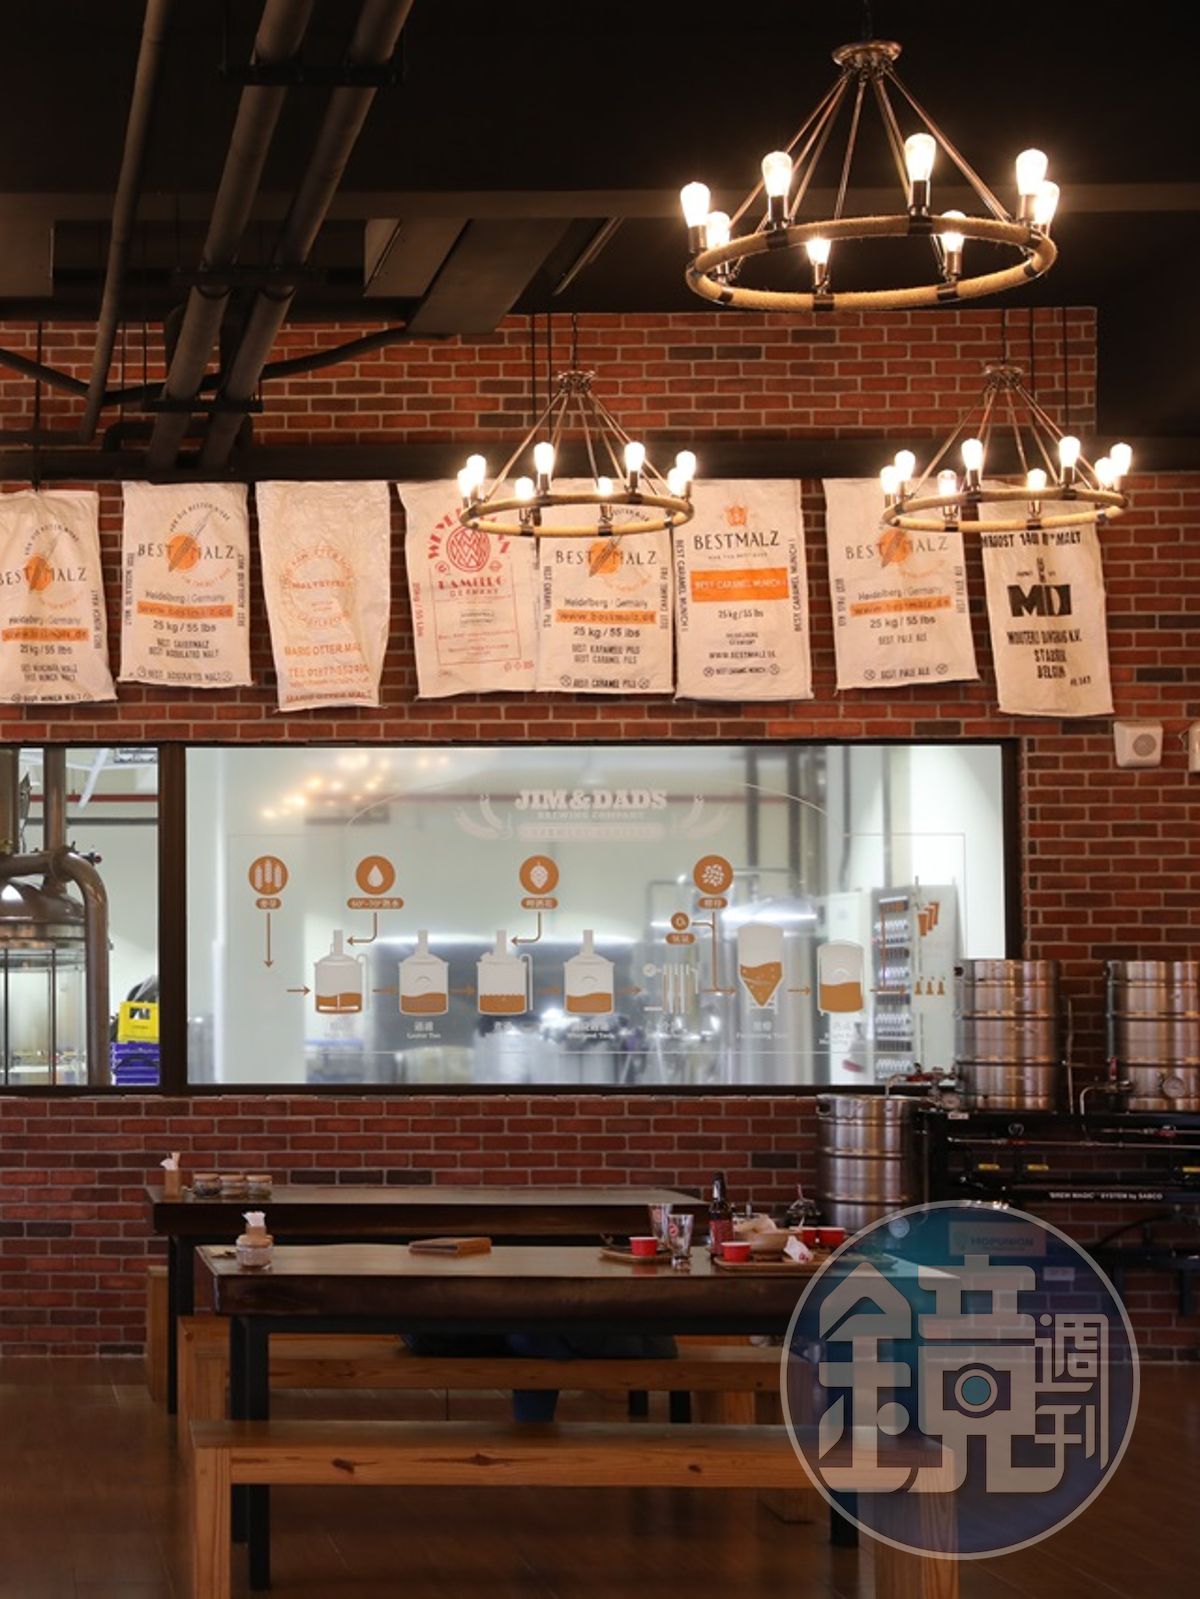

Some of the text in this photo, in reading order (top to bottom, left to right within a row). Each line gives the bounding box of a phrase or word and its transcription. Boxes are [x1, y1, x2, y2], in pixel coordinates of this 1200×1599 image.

[694, 530, 780, 550] BESTMALZ
[564, 598, 608, 608] Heidelberg
[153, 620, 216, 634] 25 kg 55 lbs
[870, 618, 882, 629] 25
[885, 618, 898, 629] kg
[906, 616, 918, 626] 55
[574, 626, 640, 639] 25 kg 55 lbs
